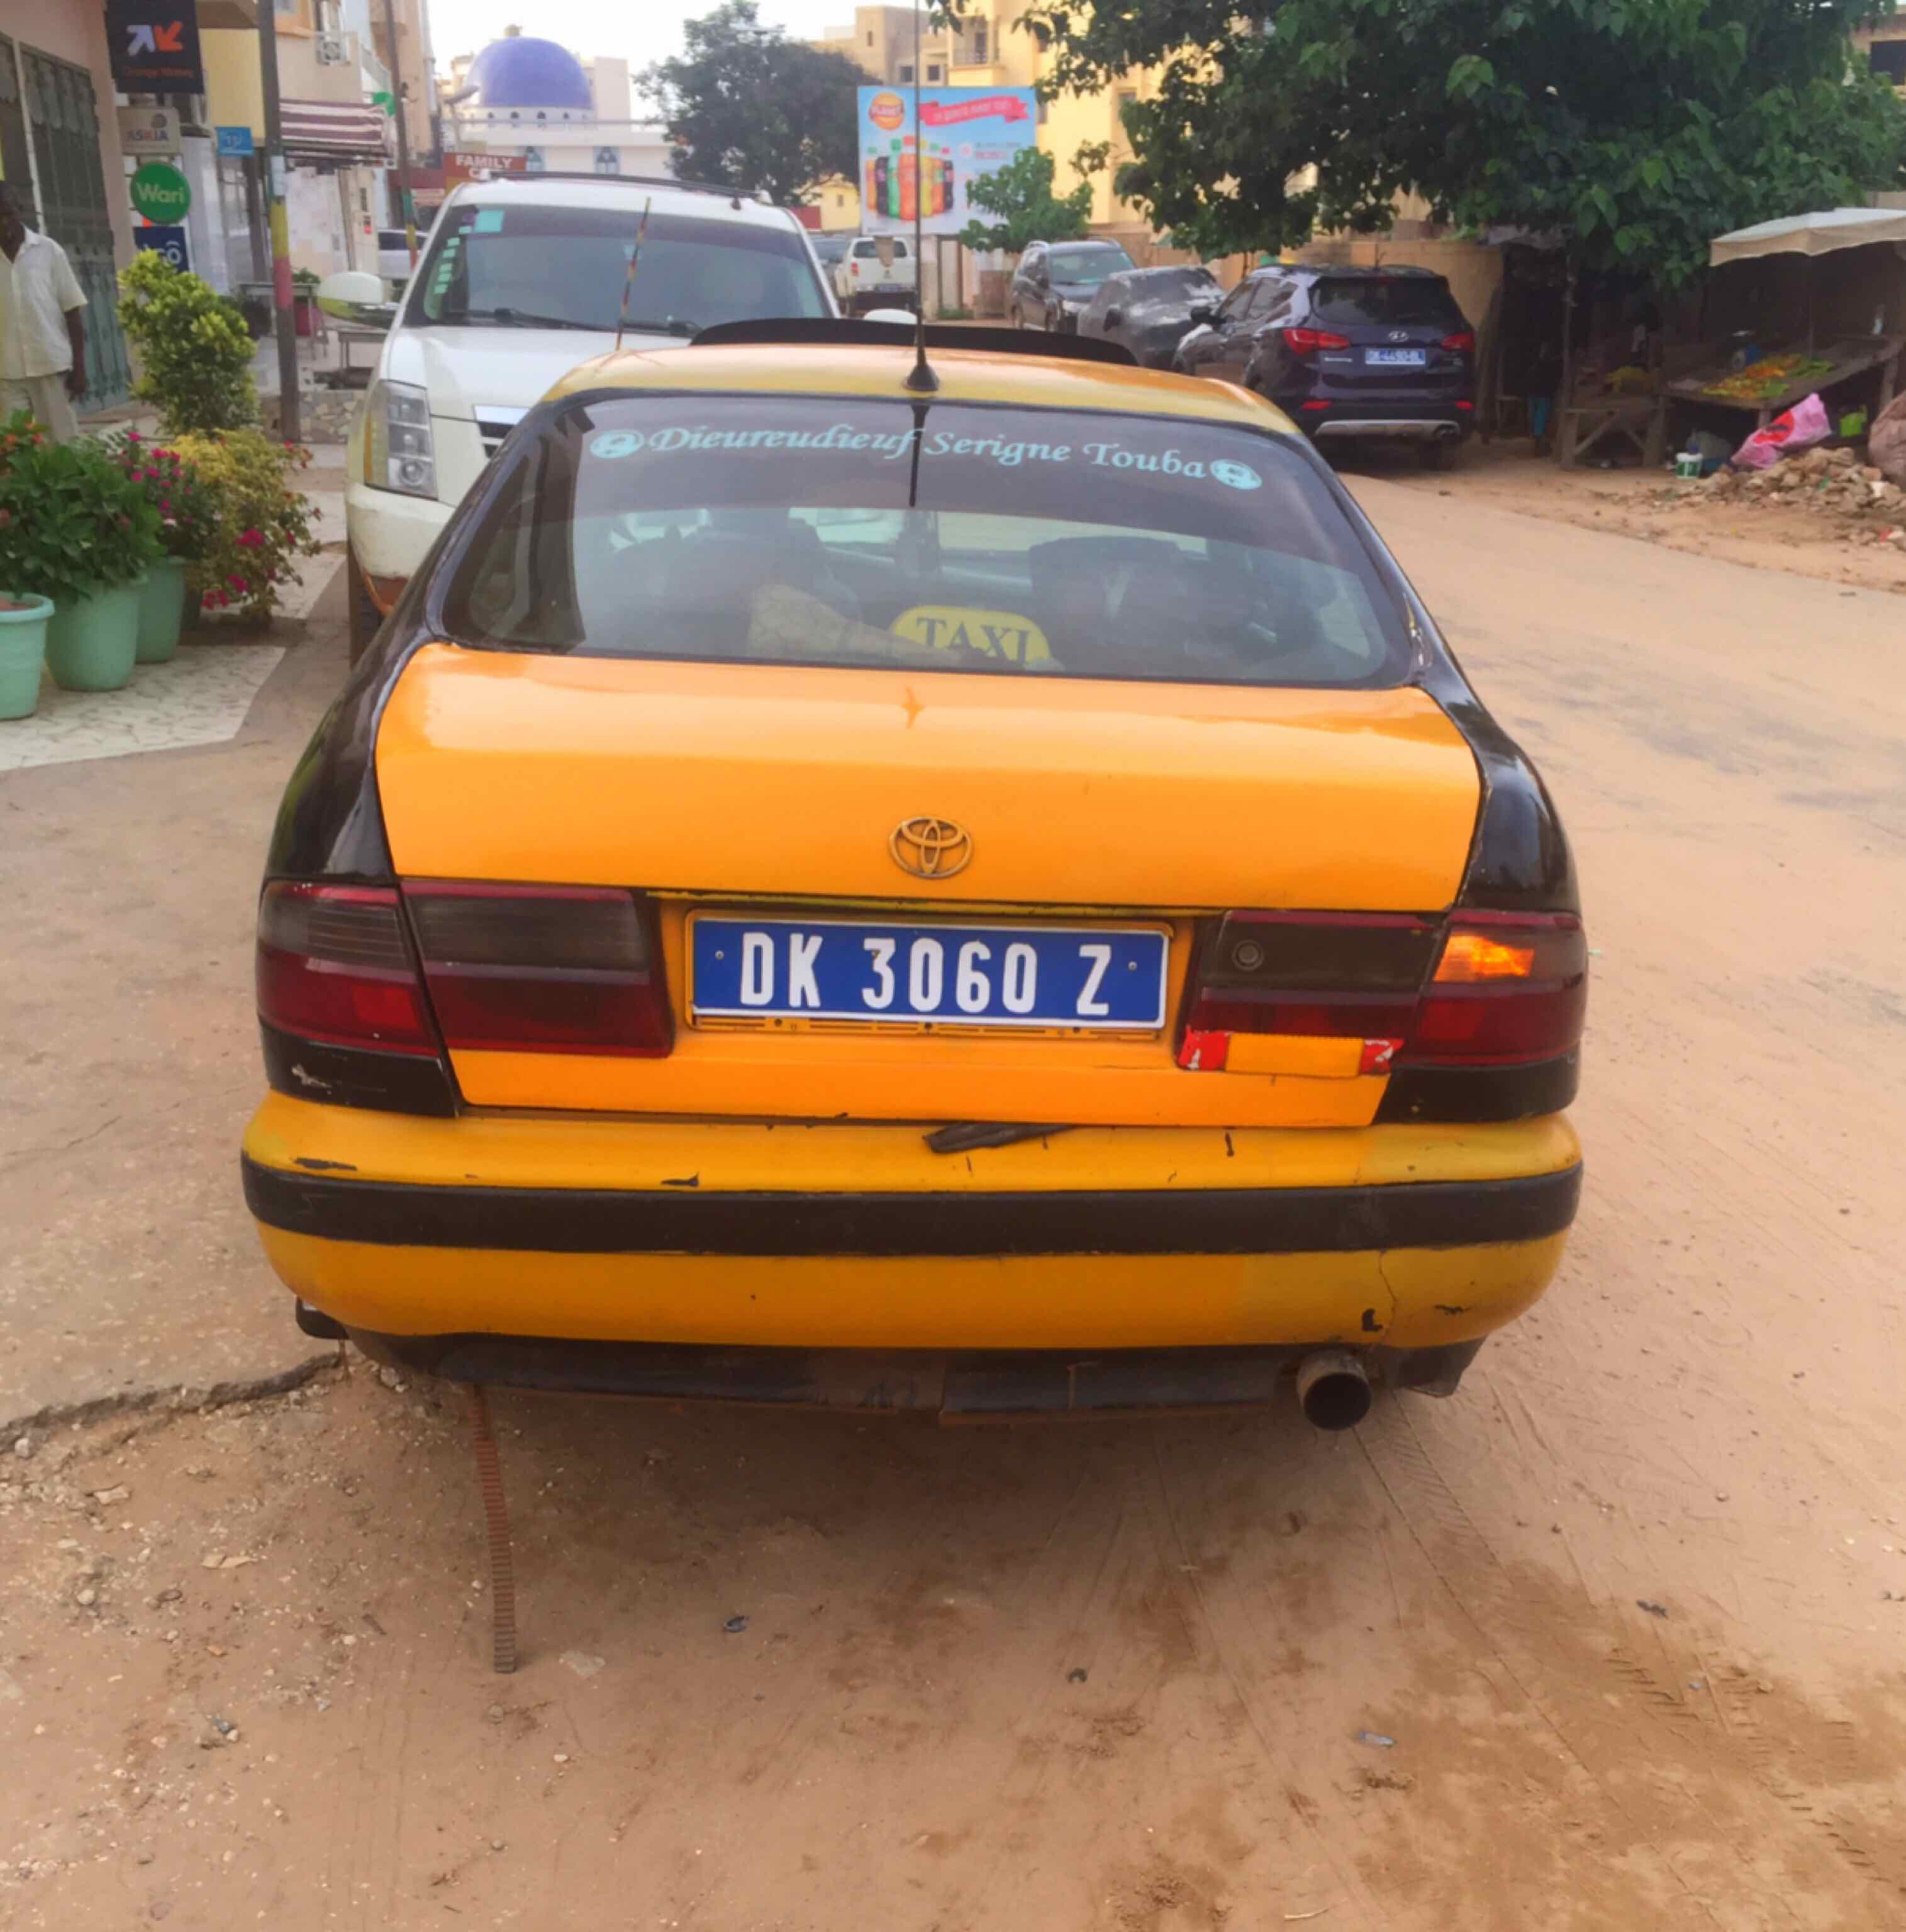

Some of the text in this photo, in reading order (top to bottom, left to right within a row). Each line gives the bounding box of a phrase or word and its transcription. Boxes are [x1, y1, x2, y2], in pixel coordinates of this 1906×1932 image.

[455, 155, 513, 170] FAMILY
[137, 182, 186, 204] Wari
[923, 431, 1071, 466] Serigne
[1083, 441, 1207, 478] Touba
[917, 616, 1030, 665] TAXI
[740, 932, 1112, 1016] DK 3060 Z
